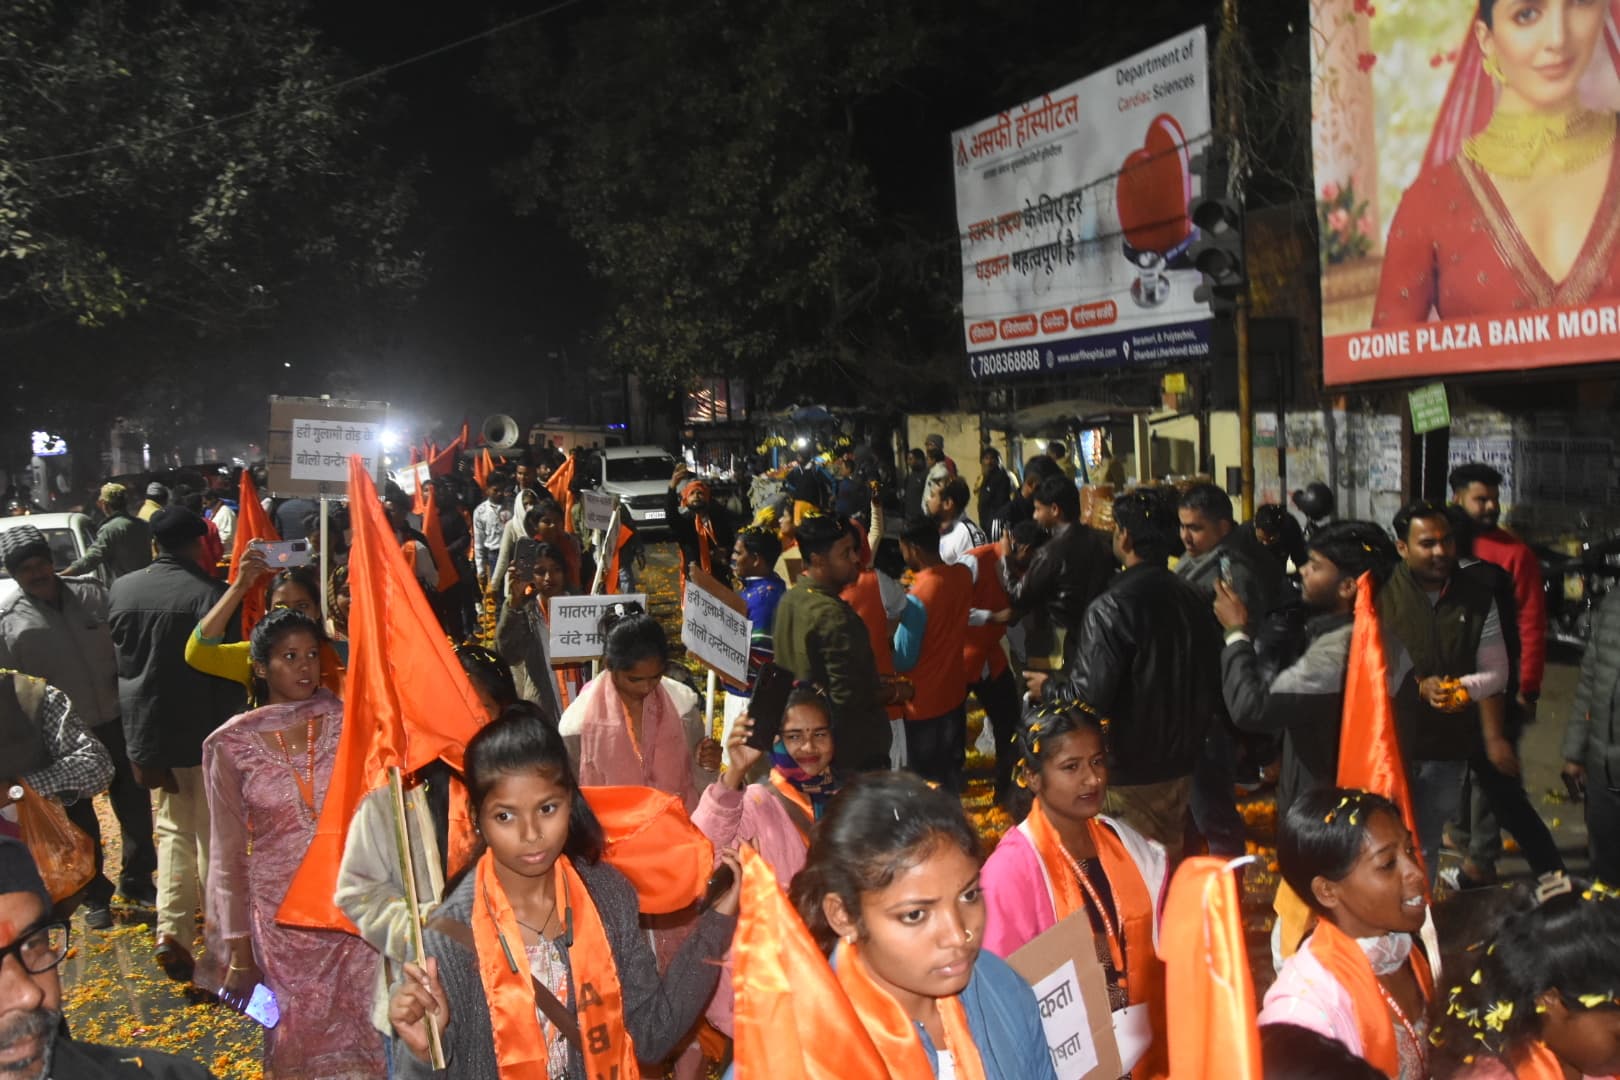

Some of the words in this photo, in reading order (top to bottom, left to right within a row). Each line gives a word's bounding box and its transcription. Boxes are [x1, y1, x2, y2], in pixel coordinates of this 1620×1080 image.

[1116, 47, 1180, 87] Department
[1181, 38, 1195, 61] of
[1152, 73, 1196, 101] Sciences
[1035, 194, 1062, 225] लिए
[1063, 190, 1082, 222] हर
[1010, 228, 1061, 274] महत्वपूर्ण
[1062, 227, 1074, 264] है
[1348, 331, 1410, 362] OZONE
[1416, 322, 1482, 353] PLAZA
[1488, 315, 1551, 346] BANK
[1557, 305, 1620, 339] MOR
[977, 349, 1041, 376] 7808368888
[295, 424, 311, 439] हरी
[313, 425, 342, 444] गुलामी
[295, 450, 320, 466] बोलो
[558, 604, 597, 619] मातरम
[687, 589, 700, 606] हरी
[701, 599, 725, 624] गुलामी
[559, 630, 583, 646] वंदे
[708, 633, 746, 666] वन्देमातरम
